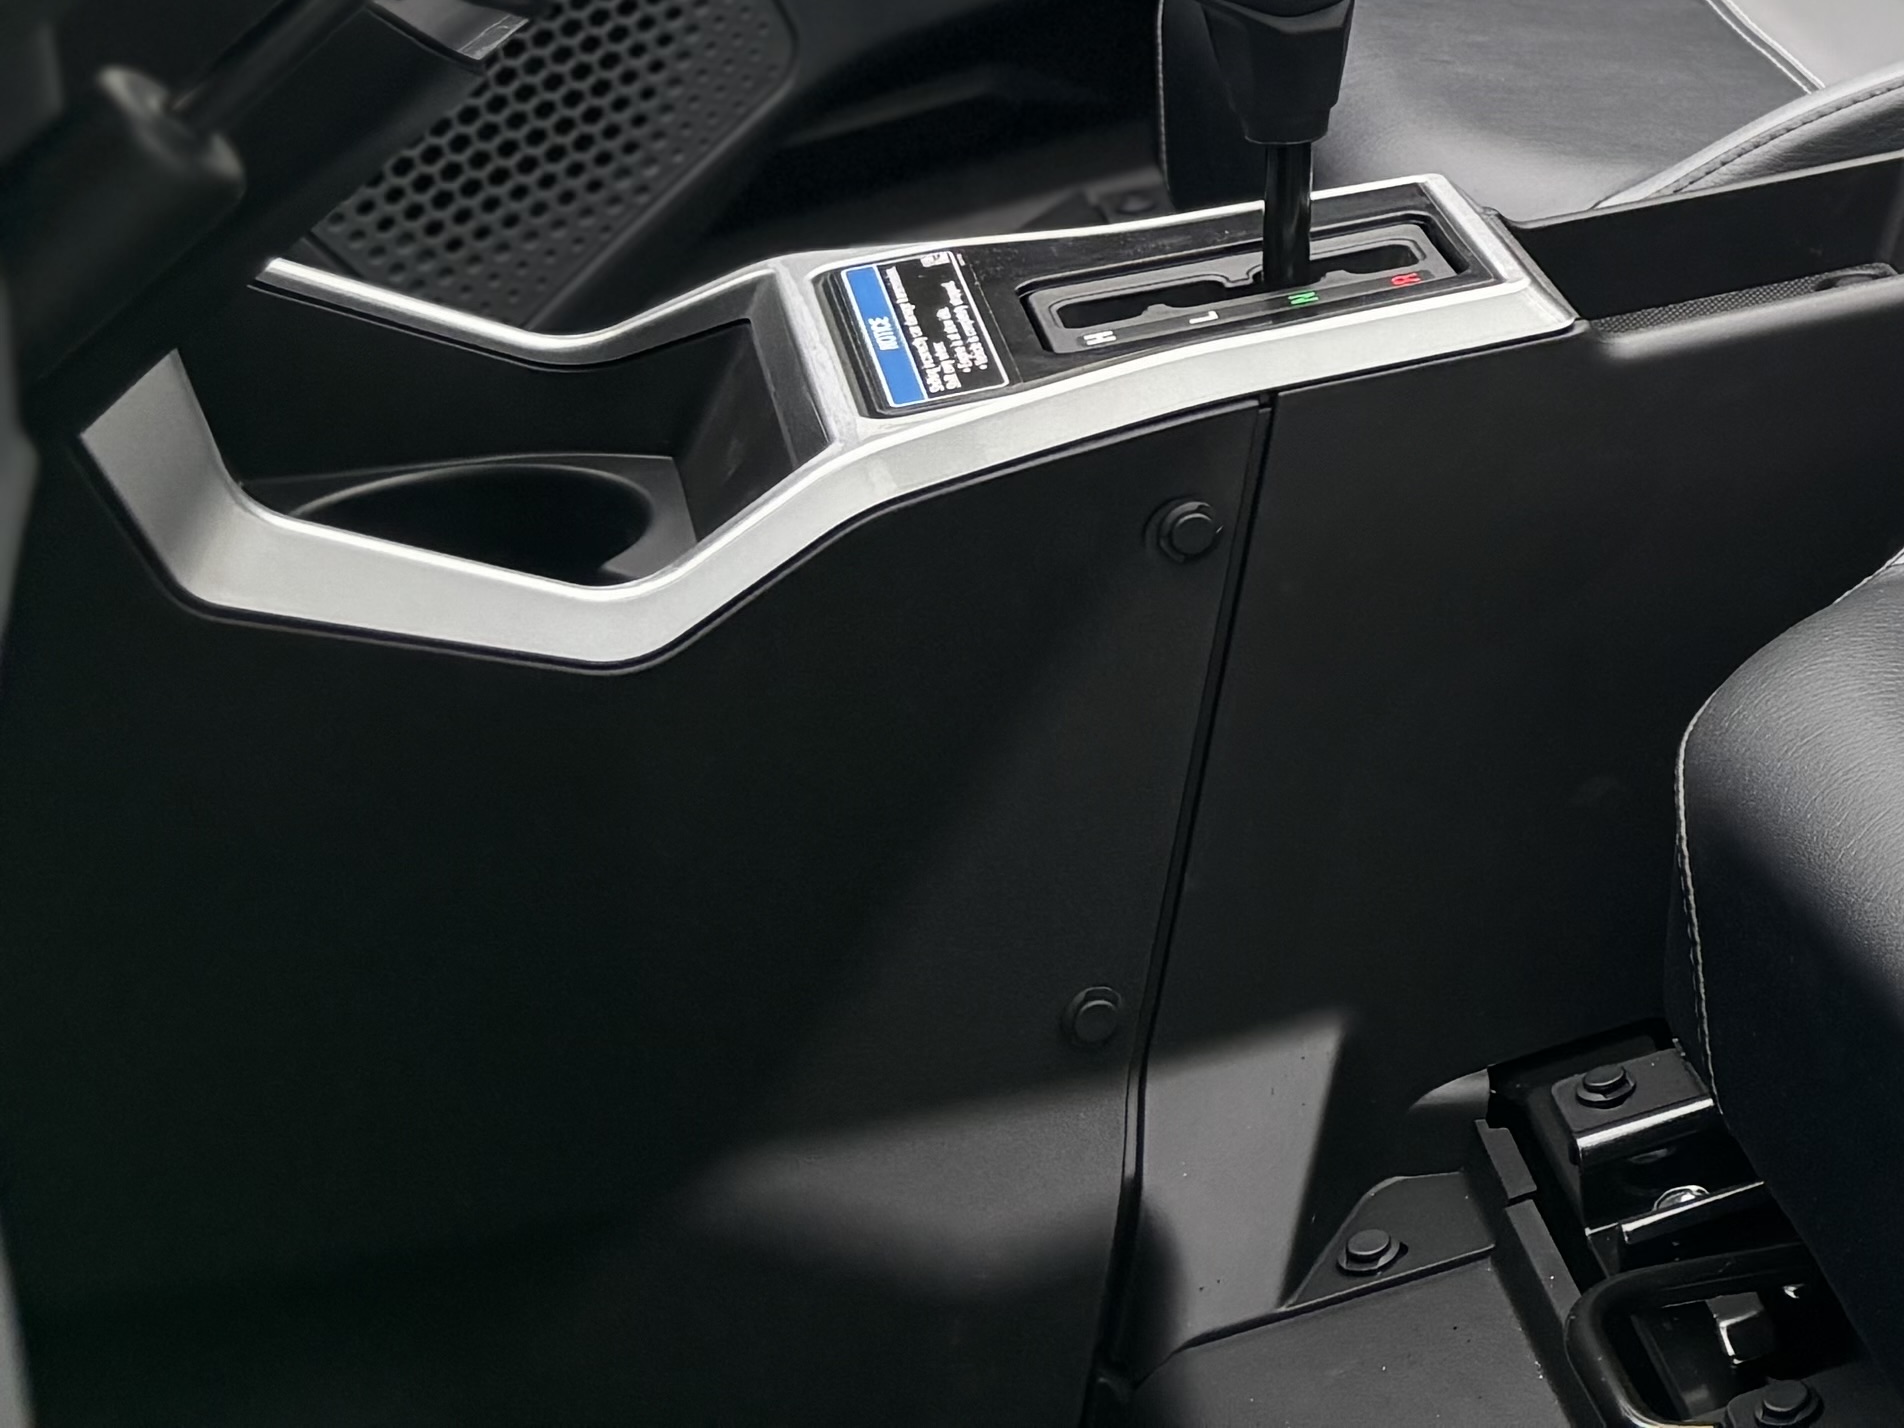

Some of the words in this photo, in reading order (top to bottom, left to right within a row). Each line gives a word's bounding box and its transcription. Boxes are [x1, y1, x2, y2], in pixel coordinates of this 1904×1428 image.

[1391, 272, 1421, 287] R
[1288, 291, 1319, 306] N
[1189, 310, 1219, 324] L
[868, 316, 899, 350] NOTICE
[1084, 330, 1116, 346] H
